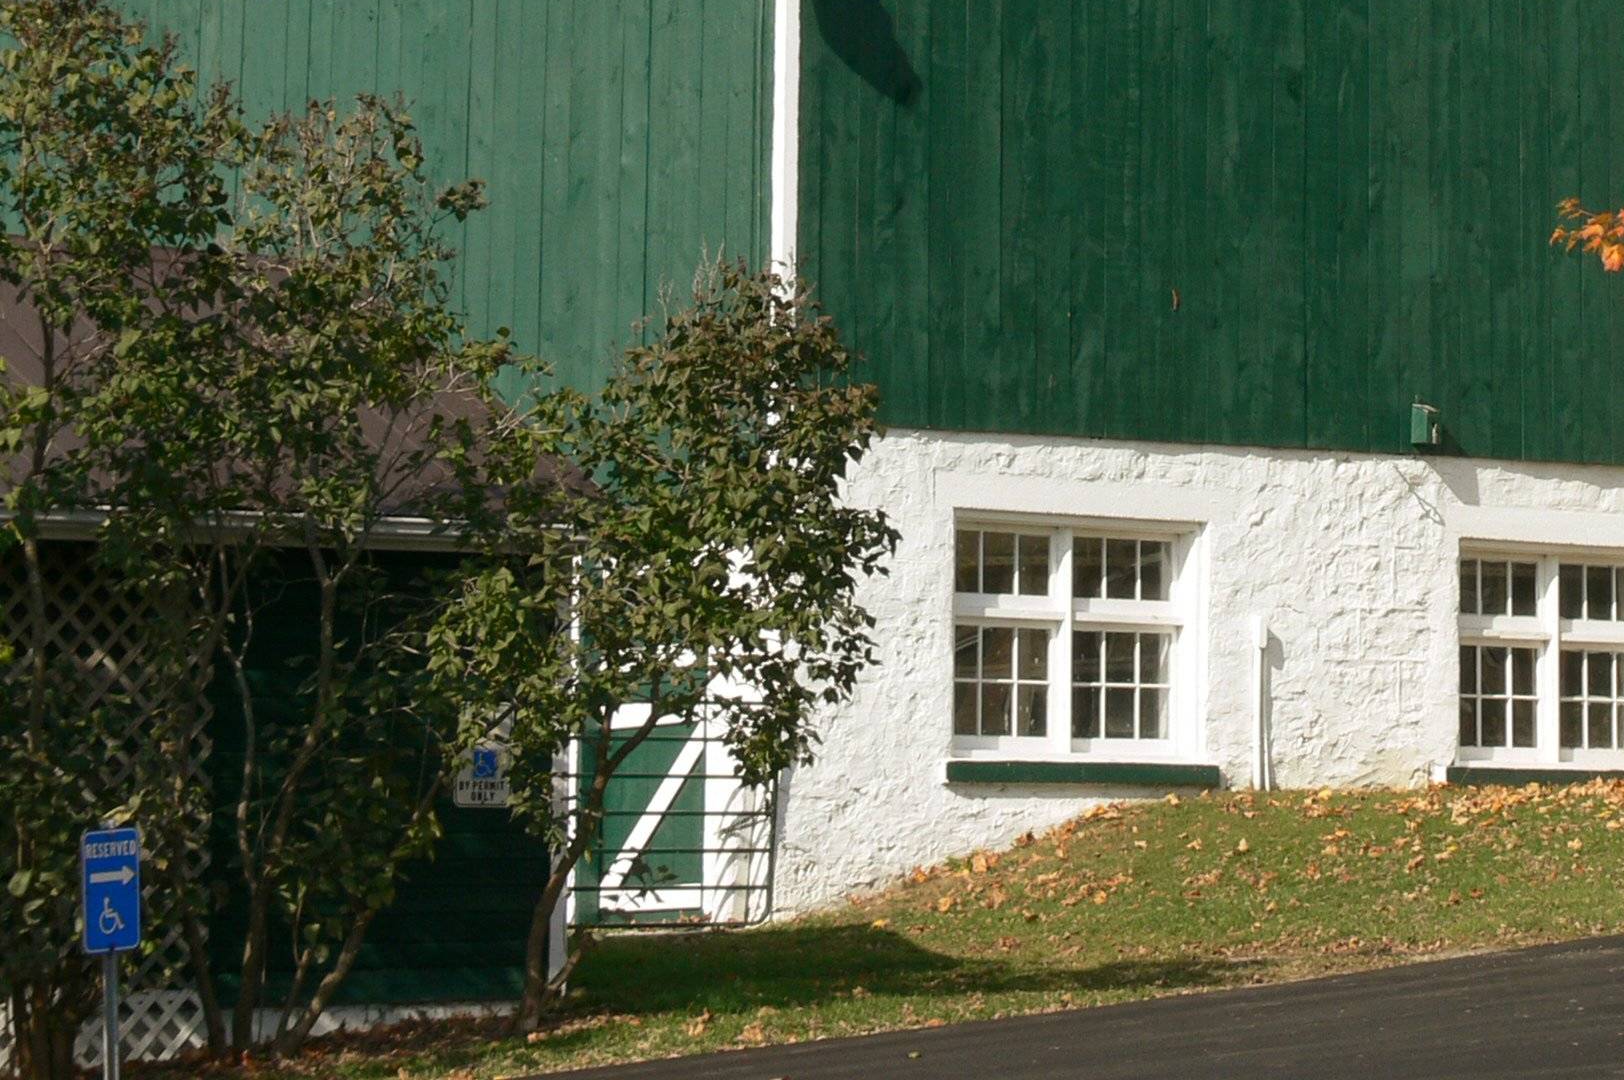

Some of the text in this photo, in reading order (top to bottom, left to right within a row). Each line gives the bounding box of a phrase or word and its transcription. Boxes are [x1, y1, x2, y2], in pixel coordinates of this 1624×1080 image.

[459, 781, 505, 790] BY PERMIT
[470, 792, 495, 801] ONLY
[86, 840, 136, 859] RESERVED
